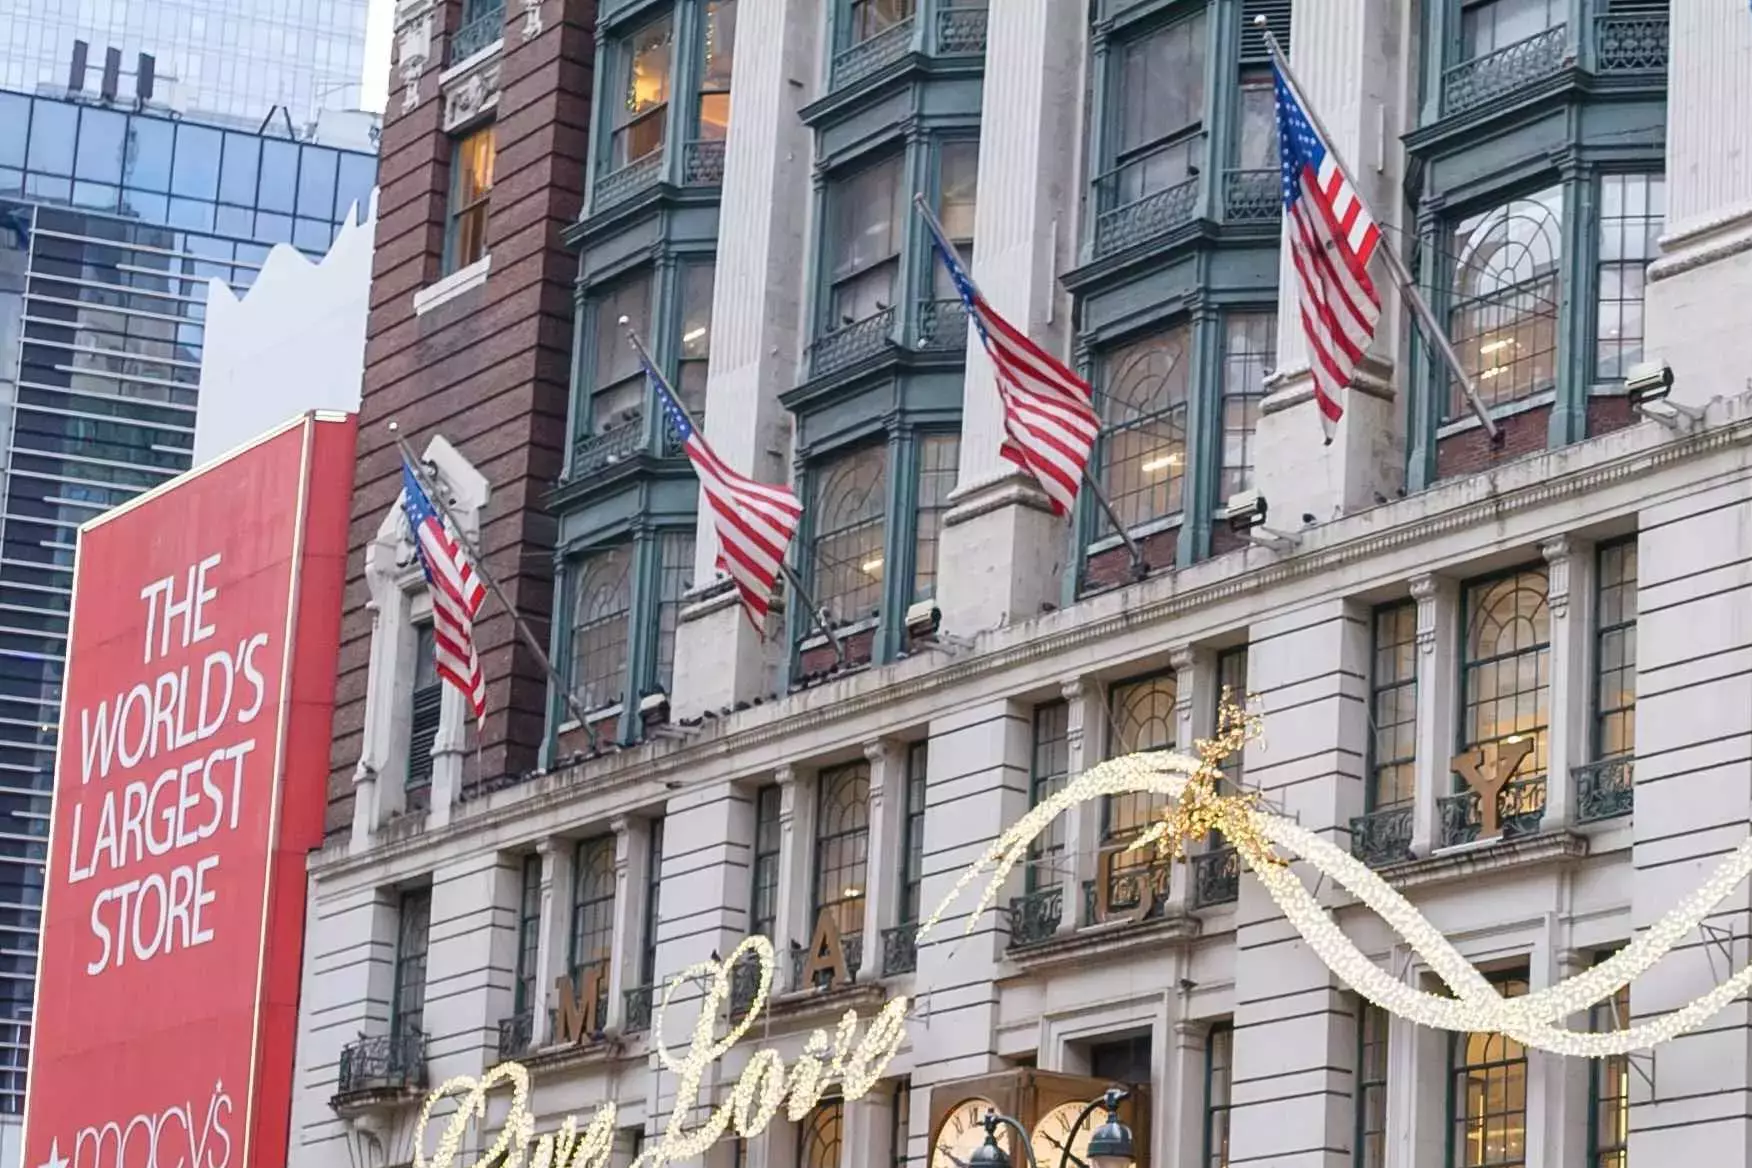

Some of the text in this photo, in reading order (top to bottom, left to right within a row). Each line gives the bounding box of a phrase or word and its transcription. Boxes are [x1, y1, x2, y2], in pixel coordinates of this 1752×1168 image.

[140, 553, 221, 662] THE
[81, 632, 268, 786] WORLD'S
[68, 741, 255, 884] LARGEST
[88, 855, 219, 976] STORE
